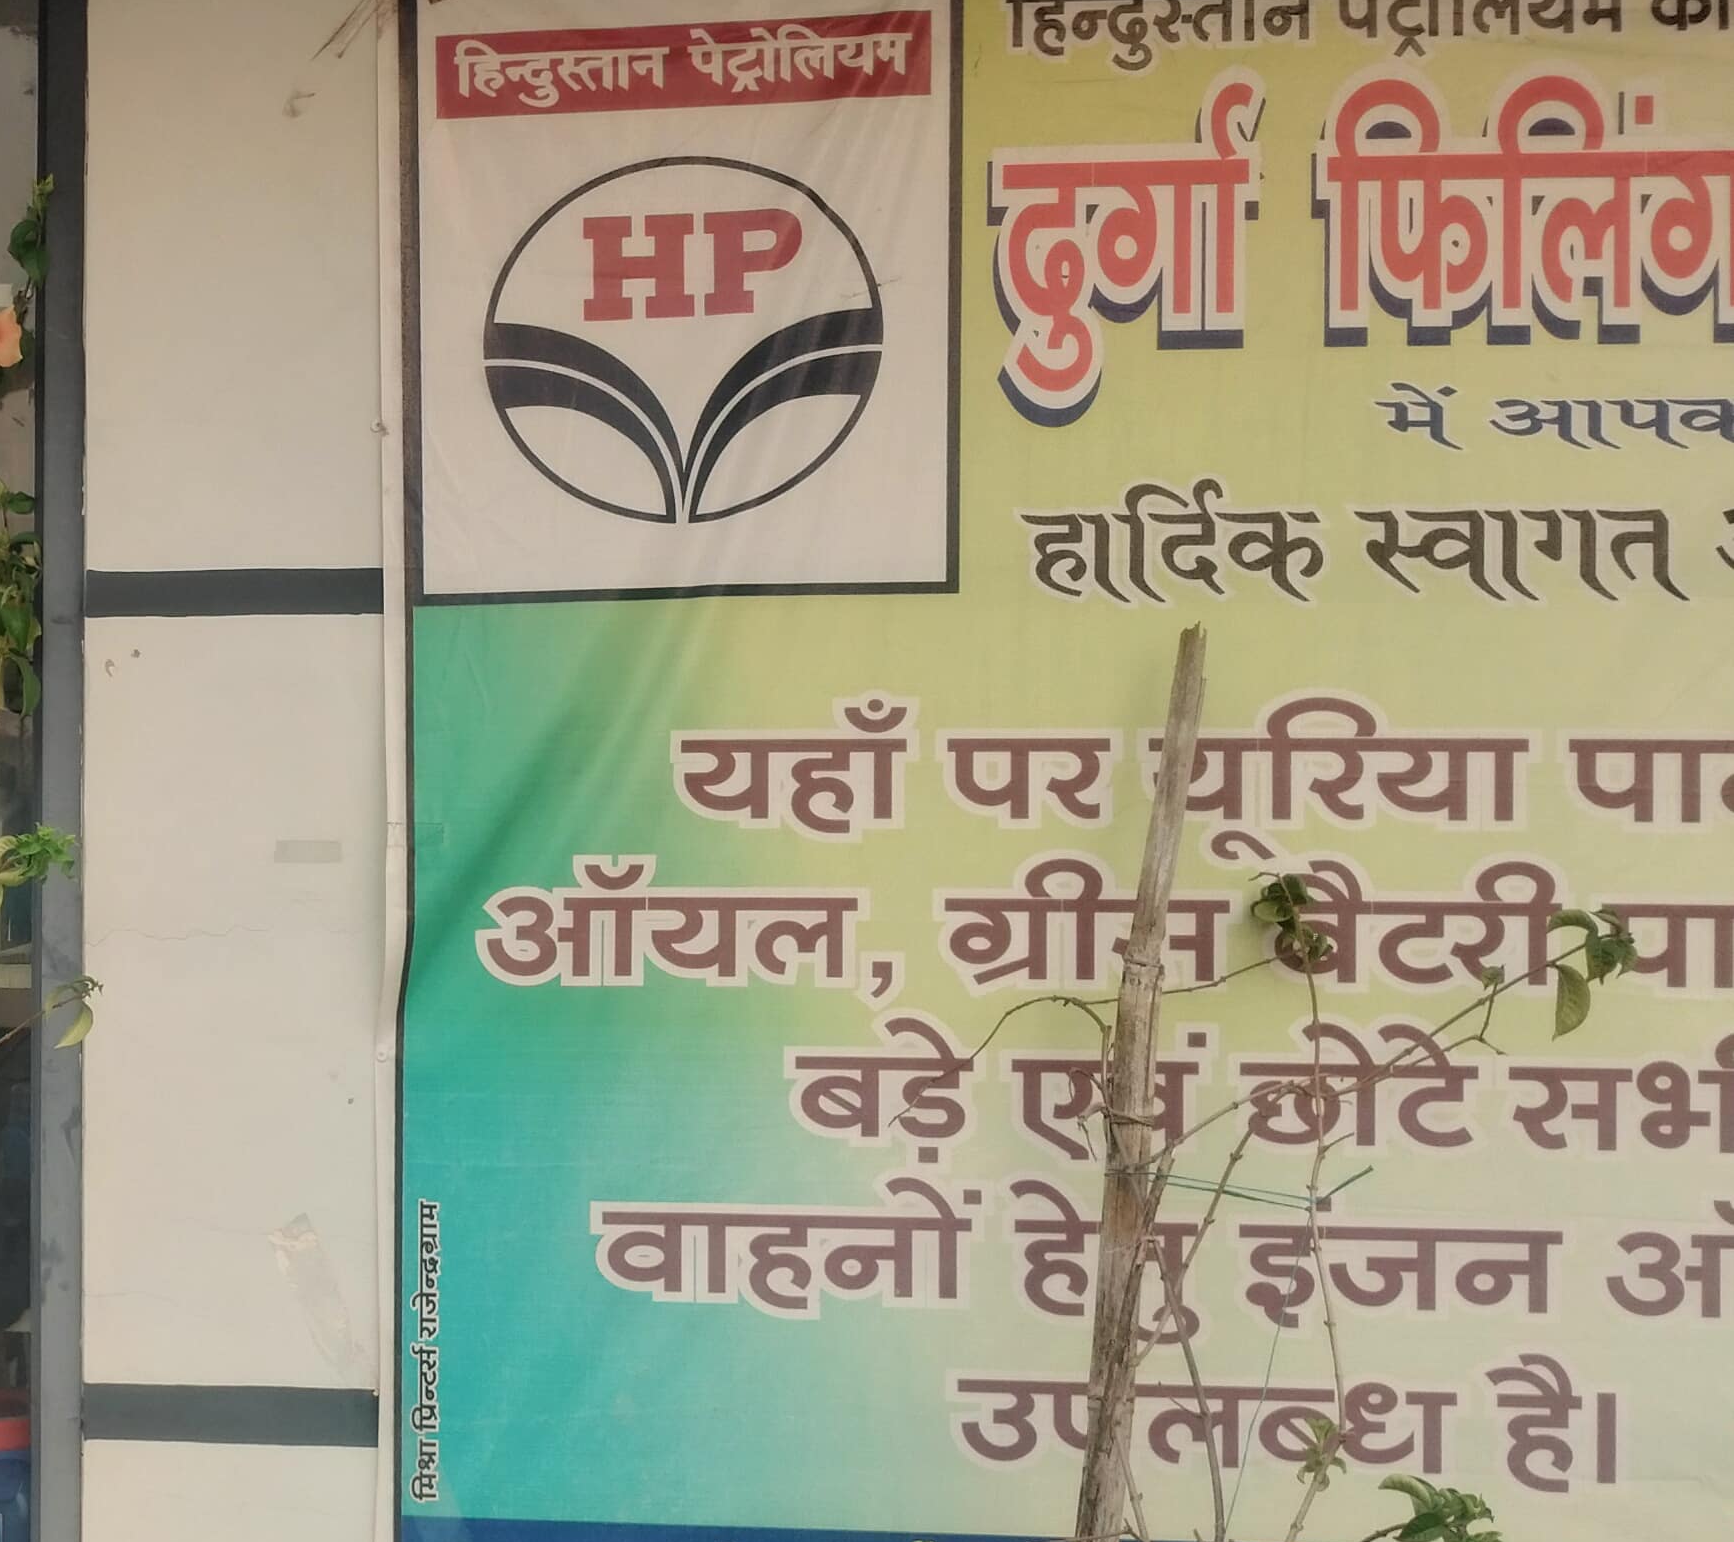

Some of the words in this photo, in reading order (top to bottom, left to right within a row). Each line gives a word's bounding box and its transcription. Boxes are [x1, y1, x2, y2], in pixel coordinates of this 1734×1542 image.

[454, 41, 669, 107] हिन्दुस्तान
[688, 25, 911, 91] पेट्रोलियम
[583, 208, 802, 321] HP
[998, 80, 1256, 397] दुर्गा
[1326, 74, 1734, 315] फिलिंग
[1375, 383, 1463, 450] में
[1020, 479, 1324, 602] हार्दिक
[1354, 509, 1690, 601] स्वागत
[682, 699, 907, 834] यहाँ
[947, 737, 1111, 820] पर
[1148, 697, 1530, 859] यूरिया
[1569, 739, 1734, 824] पा
[945, 858, 1230, 986] ग्रीन
[1270, 860, 1562, 986] बैटरी
[795, 1017, 973, 1163] बड़े
[1011, 1032, 1208, 1159] एवं
[1240, 1023, 1479, 1148] छोटे
[411, 1200, 440, 1338] राजेन्द्रग्राम
[602, 1178, 983, 1310] वाहनों
[1239, 1198, 1563, 1328] इंजन
[411, 1344, 438, 1432] प्रिन्टर्स
[957, 1379, 1458, 1474] उपलब्ध
[411, 1439, 438, 1501] मिश्रा
